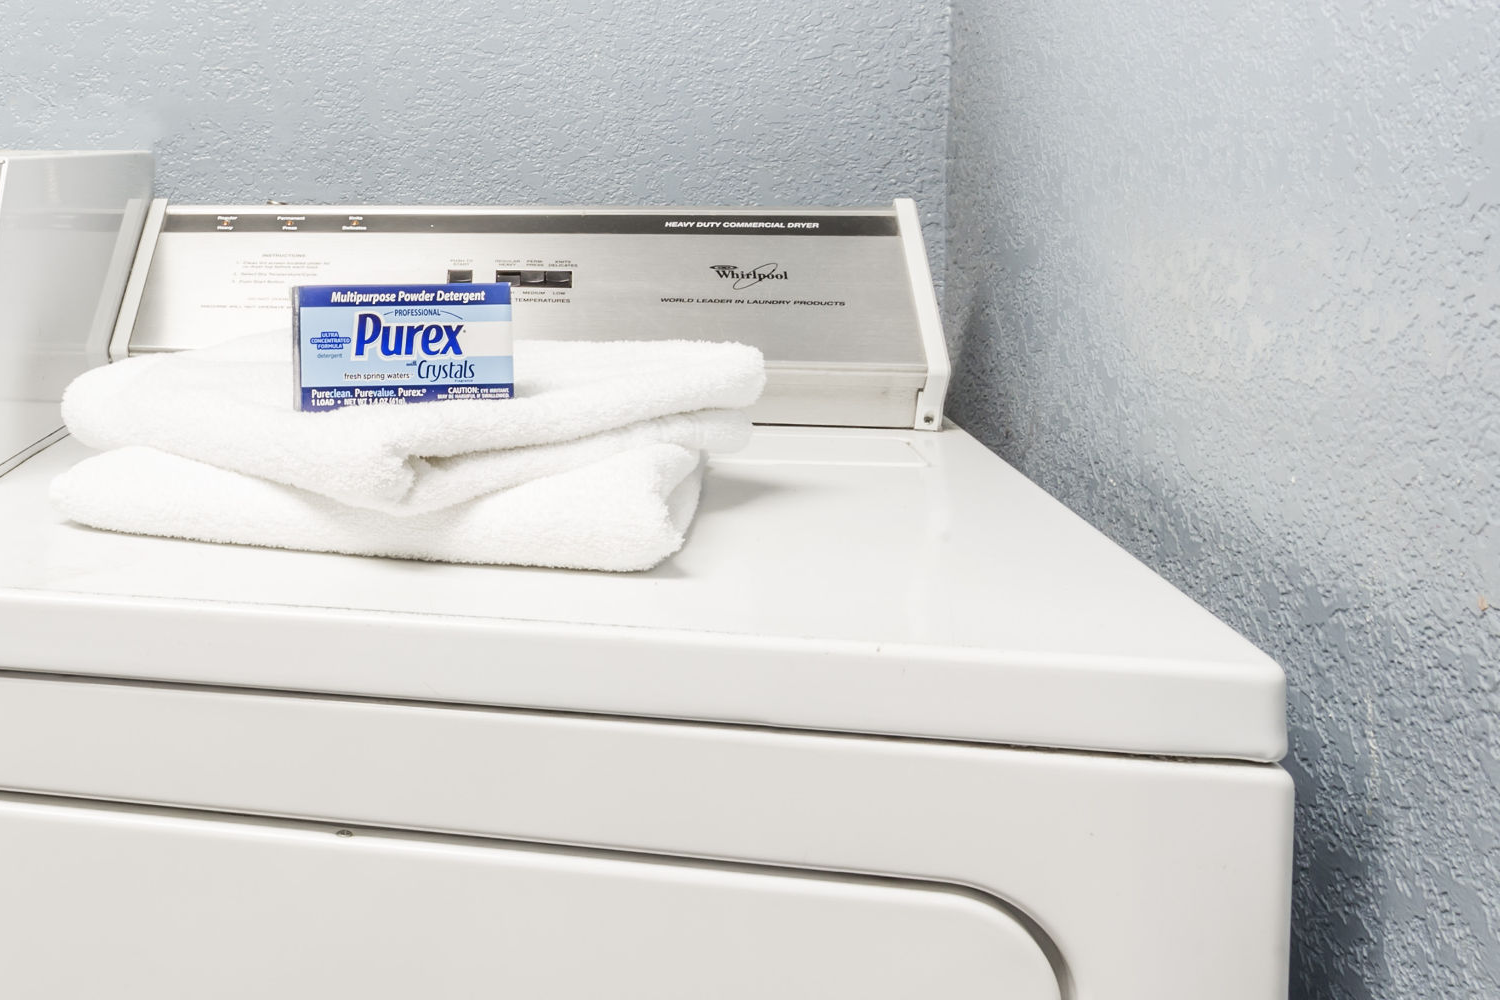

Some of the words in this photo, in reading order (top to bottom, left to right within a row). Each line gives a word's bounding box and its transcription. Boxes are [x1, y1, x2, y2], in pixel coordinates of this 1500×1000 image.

[716, 269, 788, 281] Whirlpool
[330, 291, 396, 305] Multipurpose
[397, 290, 437, 303] Powder
[436, 289, 486, 304] Detergent
[394, 308, 441, 317] PROFESSIONAL
[355, 313, 465, 357] Purex
[344, 372, 362, 380] fresh
[363, 372, 385, 381] spring
[417, 359, 476, 383] Crystals
[311, 388, 353, 399] Pureclean.
[354, 387, 396, 398] Purevalue.
[447, 386, 479, 394] CAUTION:
[343, 398, 356, 406] NET
